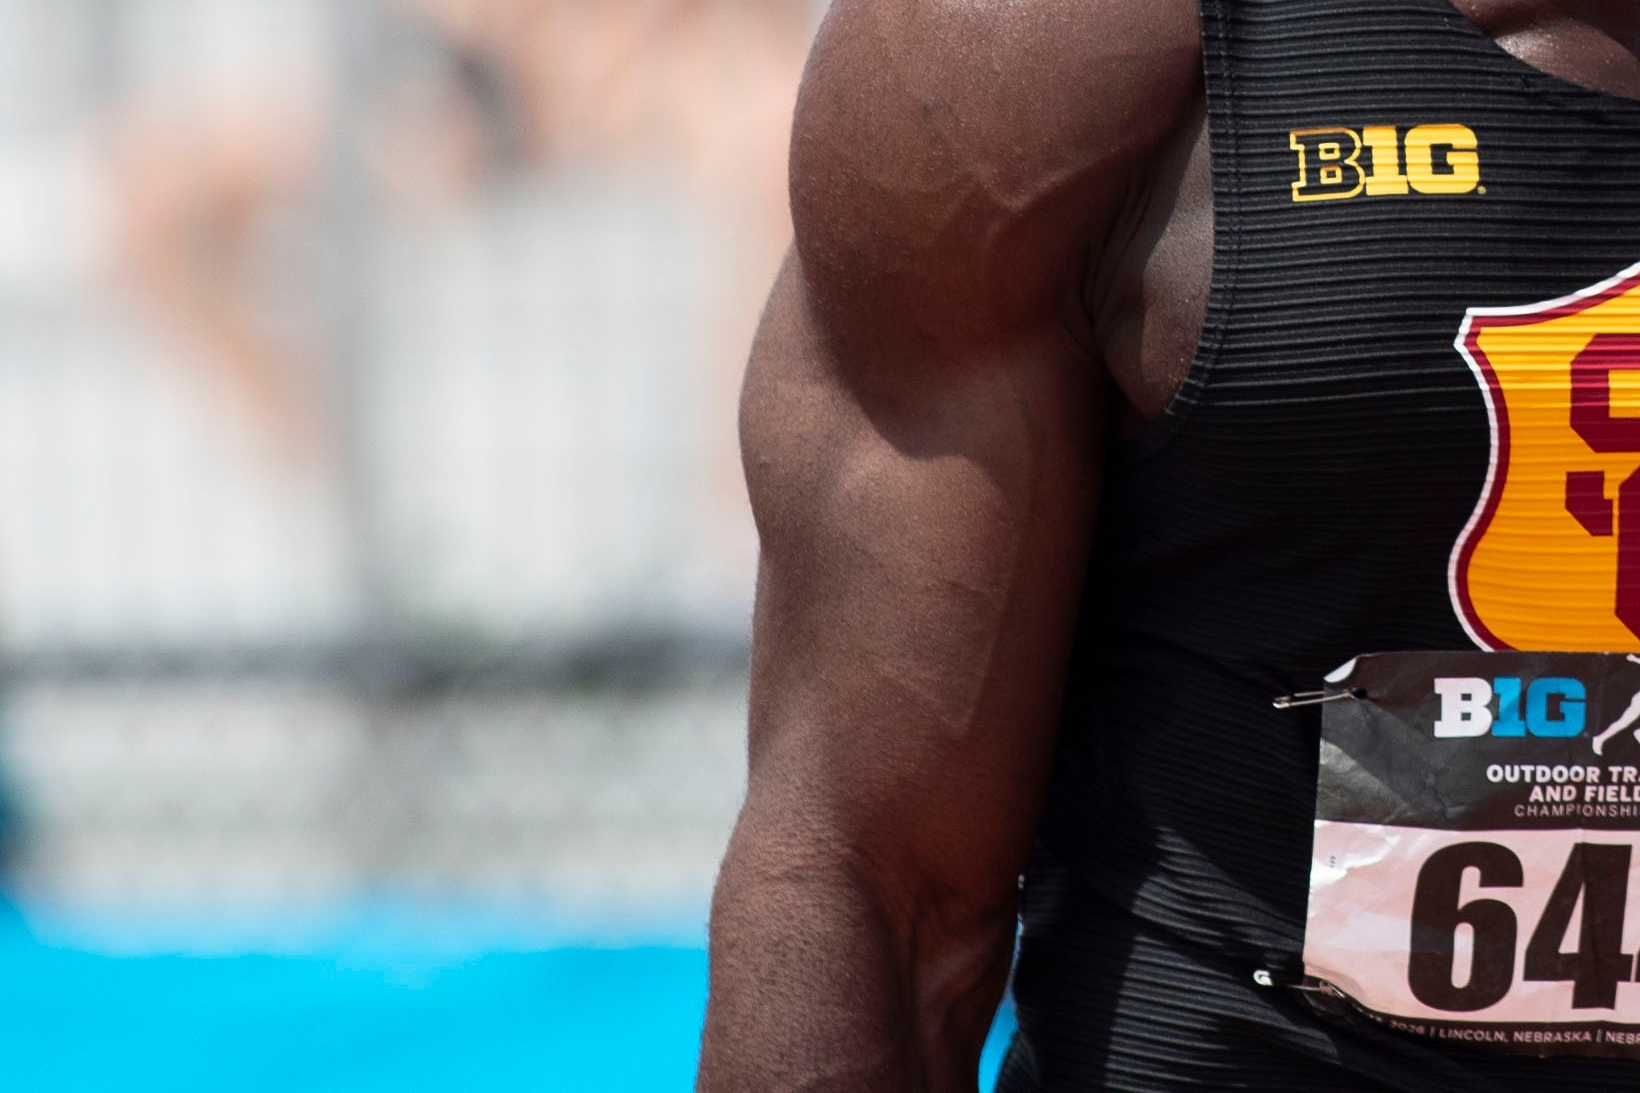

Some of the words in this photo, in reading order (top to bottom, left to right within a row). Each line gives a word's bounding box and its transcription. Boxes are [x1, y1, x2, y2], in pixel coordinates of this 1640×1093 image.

[1486, 764, 1601, 783] OUTDOOR
[1529, 785, 1577, 803] AND
[1513, 1030, 1591, 1044] NEBRASKA
